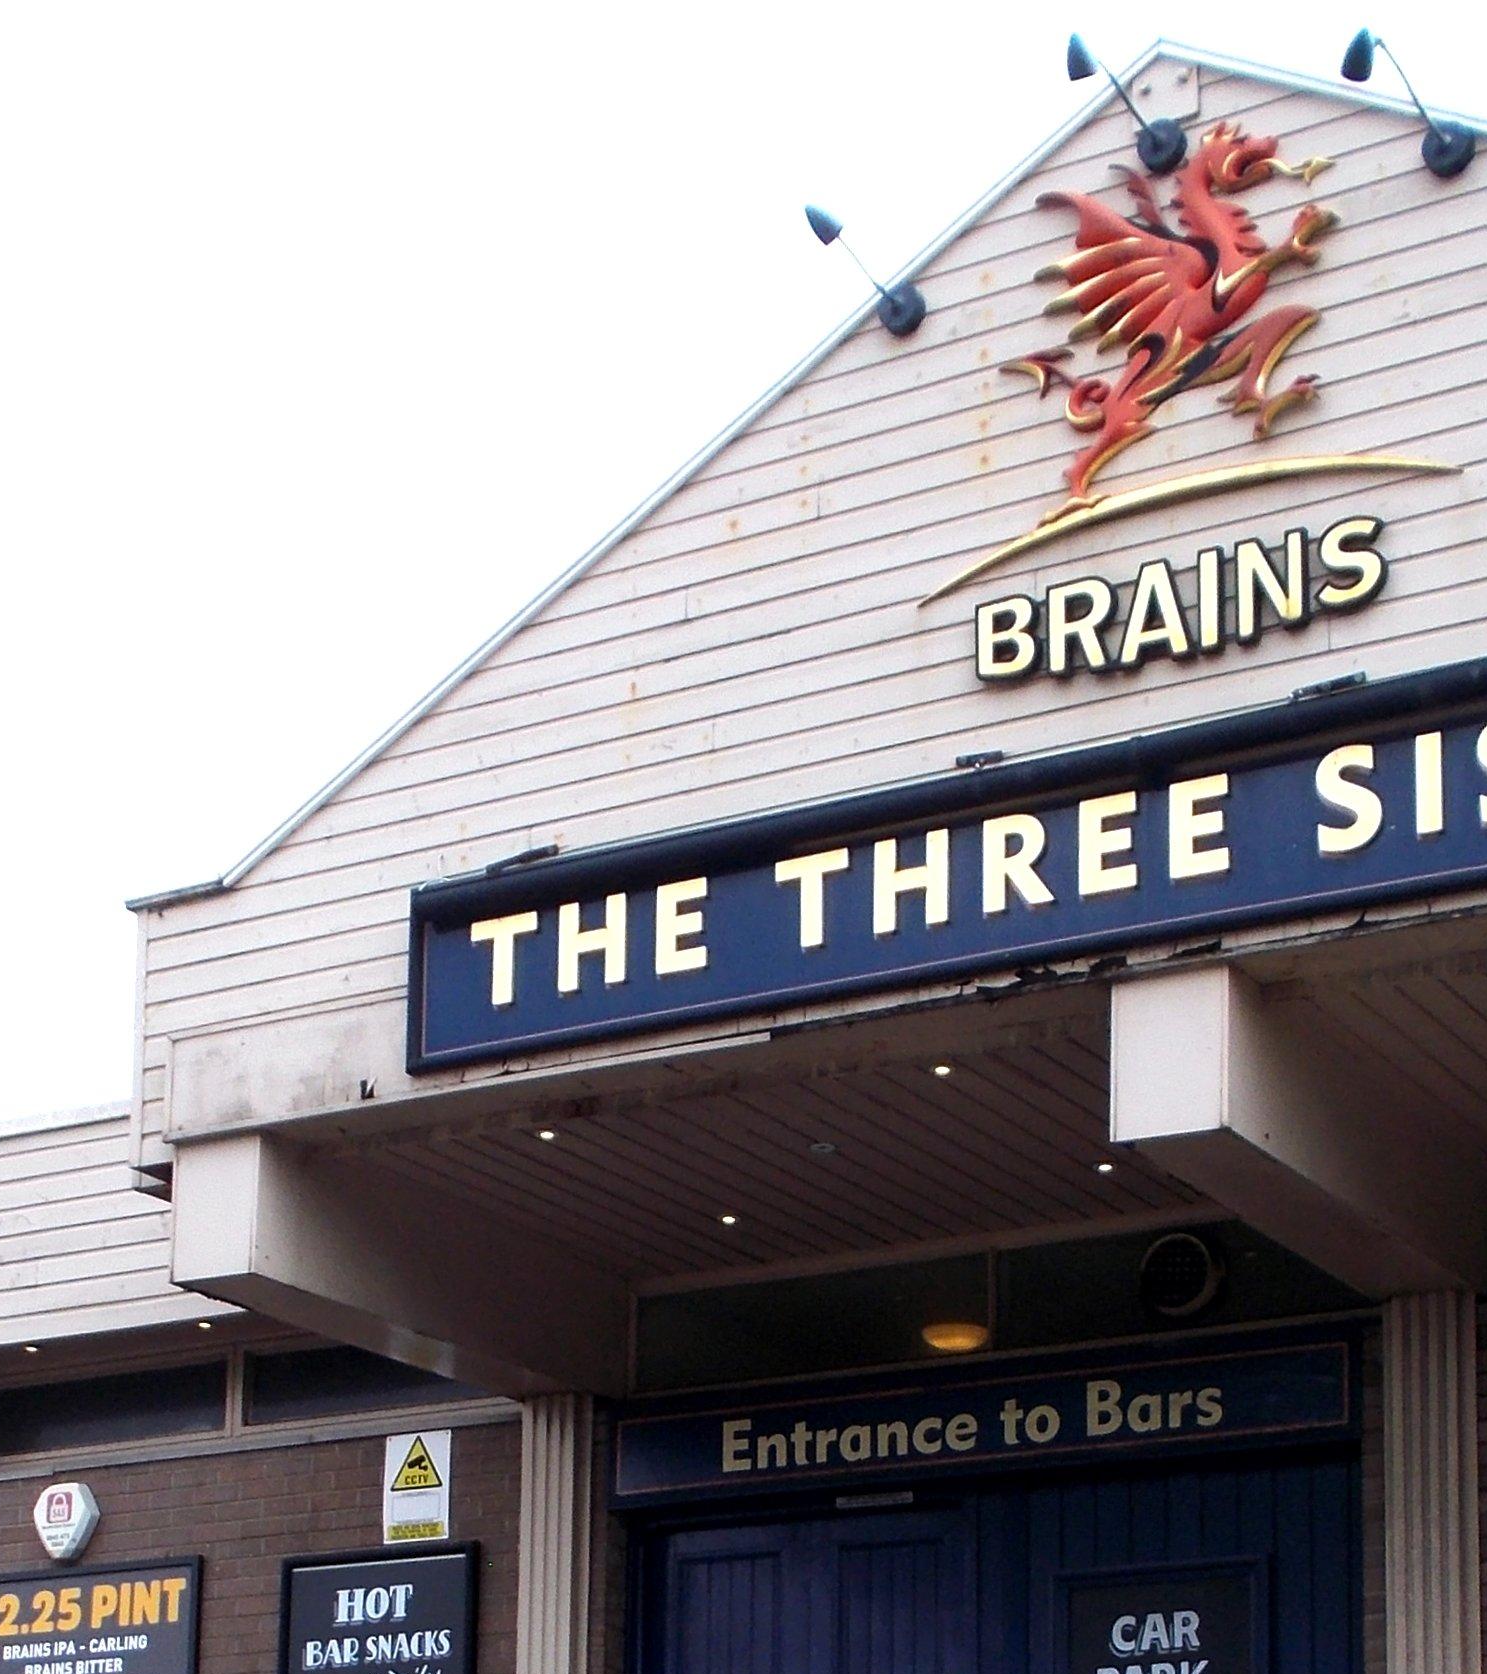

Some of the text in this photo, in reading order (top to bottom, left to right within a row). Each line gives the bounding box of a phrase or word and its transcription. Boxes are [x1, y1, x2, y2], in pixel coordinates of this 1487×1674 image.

[975, 515, 1389, 683] BRAINS
[470, 876, 709, 1007] THE
[774, 772, 1230, 950] THREE
[722, 1379, 1223, 1472] Entrance to Bars
[405, 1475, 429, 1485] CCTV
[91, 1578, 186, 1629] PINT
[335, 1584, 413, 1624] HOT
[3, 1643, 51, 1660] BRAINS
[53, 1640, 76, 1657] IPA
[89, 1635, 148, 1653] CARLING
[304, 1629, 451, 1668] BAR SNACKS
[1110, 1610, 1201, 1655] CAR
[75, 1657, 123, 1674] BITTER
